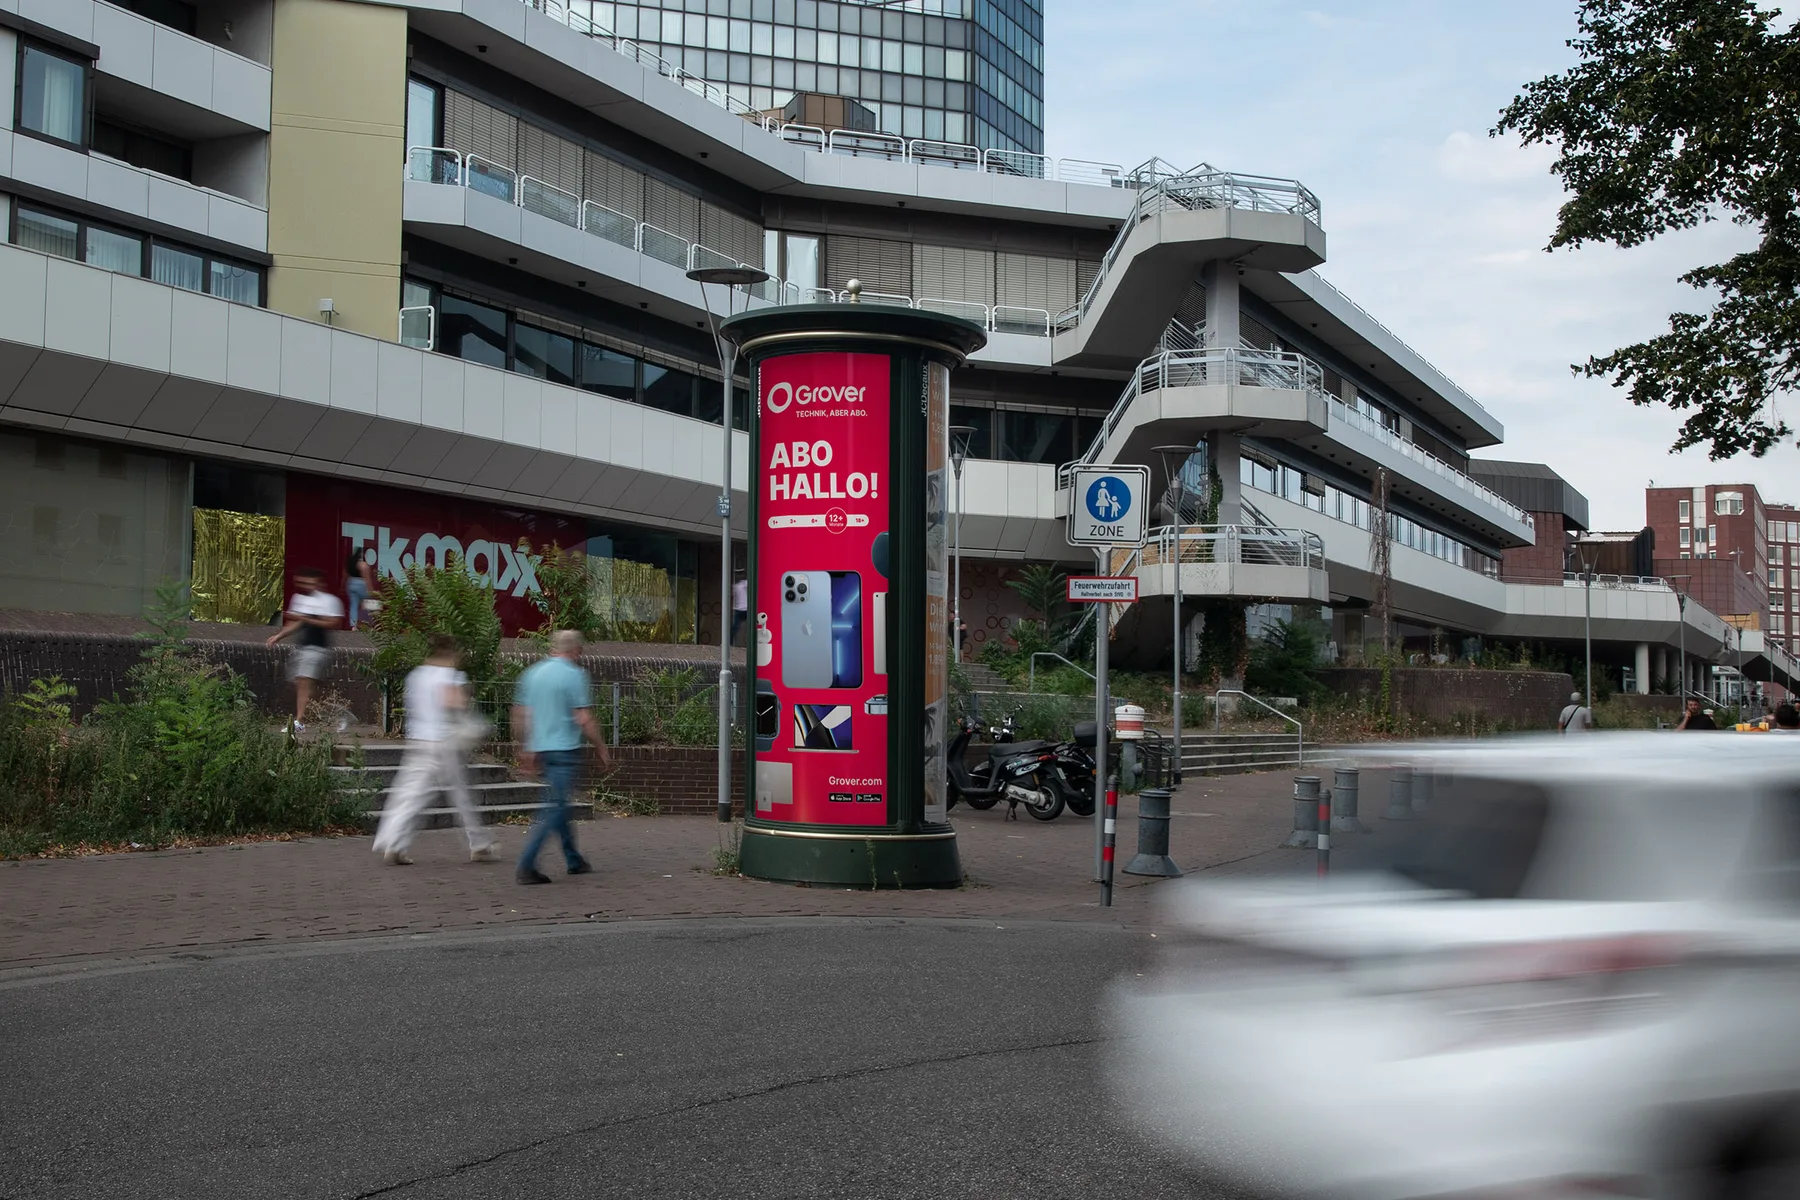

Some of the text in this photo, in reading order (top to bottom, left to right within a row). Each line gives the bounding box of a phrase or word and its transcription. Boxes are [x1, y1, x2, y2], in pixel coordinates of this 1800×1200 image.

[795, 385, 866, 405] Grover
[920, 364, 928, 417] JCDecaux
[796, 409, 868, 418] TECHNIK, ABER ABO.
[769, 440, 833, 469] ABO
[769, 472, 879, 501] HALLO!
[828, 514, 843, 522] 12+
[1089, 525, 1125, 537] ZONE
[1074, 581, 1131, 590] Feuerwehrzufahrt
[828, 776, 883, 786] Grover.com
